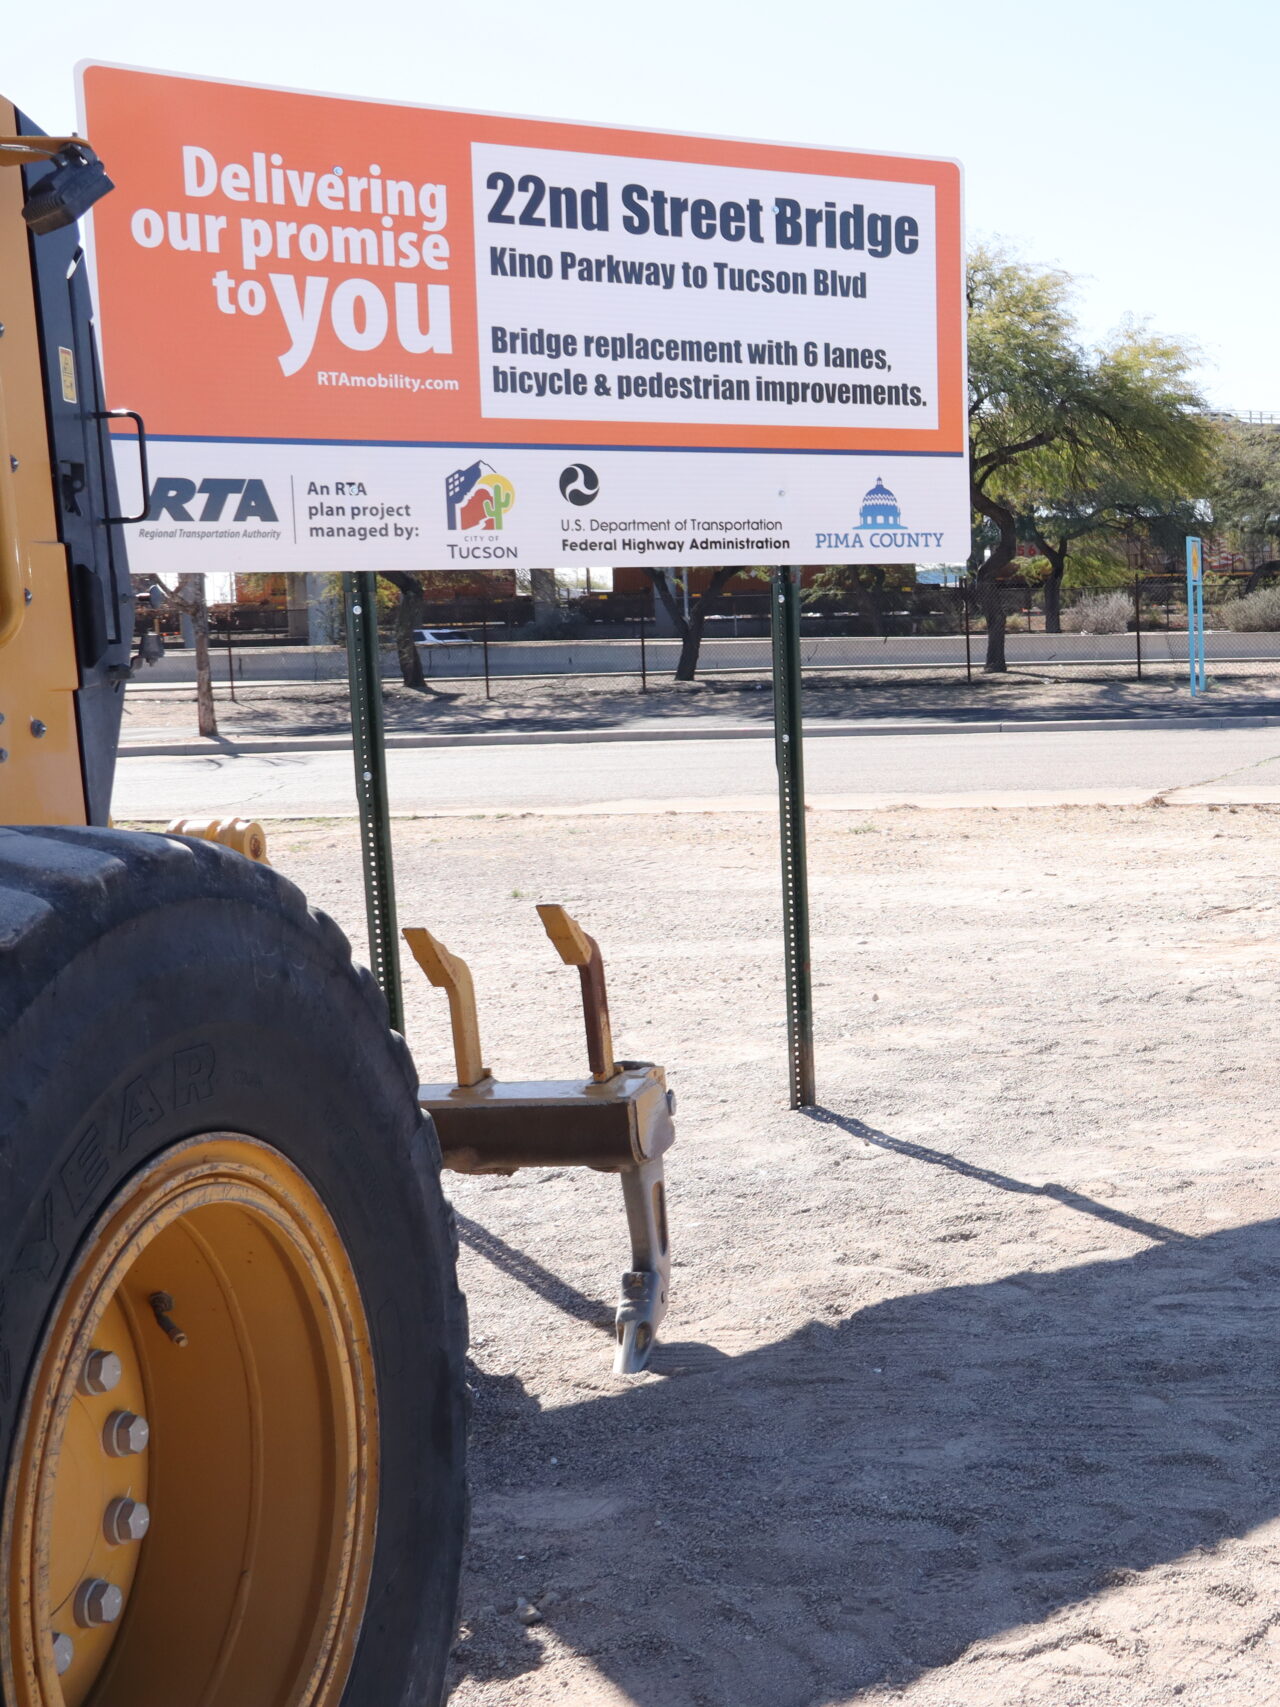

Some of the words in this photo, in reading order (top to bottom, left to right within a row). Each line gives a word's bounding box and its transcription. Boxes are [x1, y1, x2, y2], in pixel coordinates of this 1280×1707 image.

[182, 145, 448, 232] Delivering
[486, 171, 610, 232] 22nd
[621, 183, 764, 244] Street
[775, 197, 919, 259] Bridge
[130, 208, 227, 254] our
[240, 215, 451, 271] promise
[489, 246, 553, 280] Kino
[560, 251, 675, 291] Parkway
[682, 260, 707, 290] to
[713, 262, 807, 295] Tucson
[814, 269, 867, 299] Blvd
[212, 270, 267, 316] to
[268, 273, 453, 377] you
[491, 326, 577, 360] Bridge
[584, 332, 742, 364] replacement
[747, 340, 798, 366] with
[803, 342, 818, 367] 6
[824, 343, 892, 373] lanes,
[317, 371, 460, 393] RTAmobility.com
[492, 366, 588, 398] bicycle
[594, 373, 612, 397] &
[617, 373, 750, 402] pedestrian
[755, 376, 928, 408] improvements.
[147, 476, 280, 522] RTA
[307, 481, 331, 496] An
[335, 482, 367, 497] RTA
[308, 502, 348, 520] plan
[351, 502, 411, 521] project
[561, 519, 586, 532] U.S.
[590, 519, 671, 534] Department
[674, 518, 688, 531] of
[689, 518, 783, 534] Transportation
[138, 528, 177, 540] Regional
[178, 529, 240, 541] Transportation
[242, 529, 281, 541] Authority
[309, 523, 390, 541] managed
[393, 524, 419, 541] by:
[562, 538, 618, 552] Federal
[622, 538, 685, 553] Highway
[689, 537, 790, 551] Administration
[815, 532, 865, 548] PIMA
[869, 532, 944, 548] COUNTY
